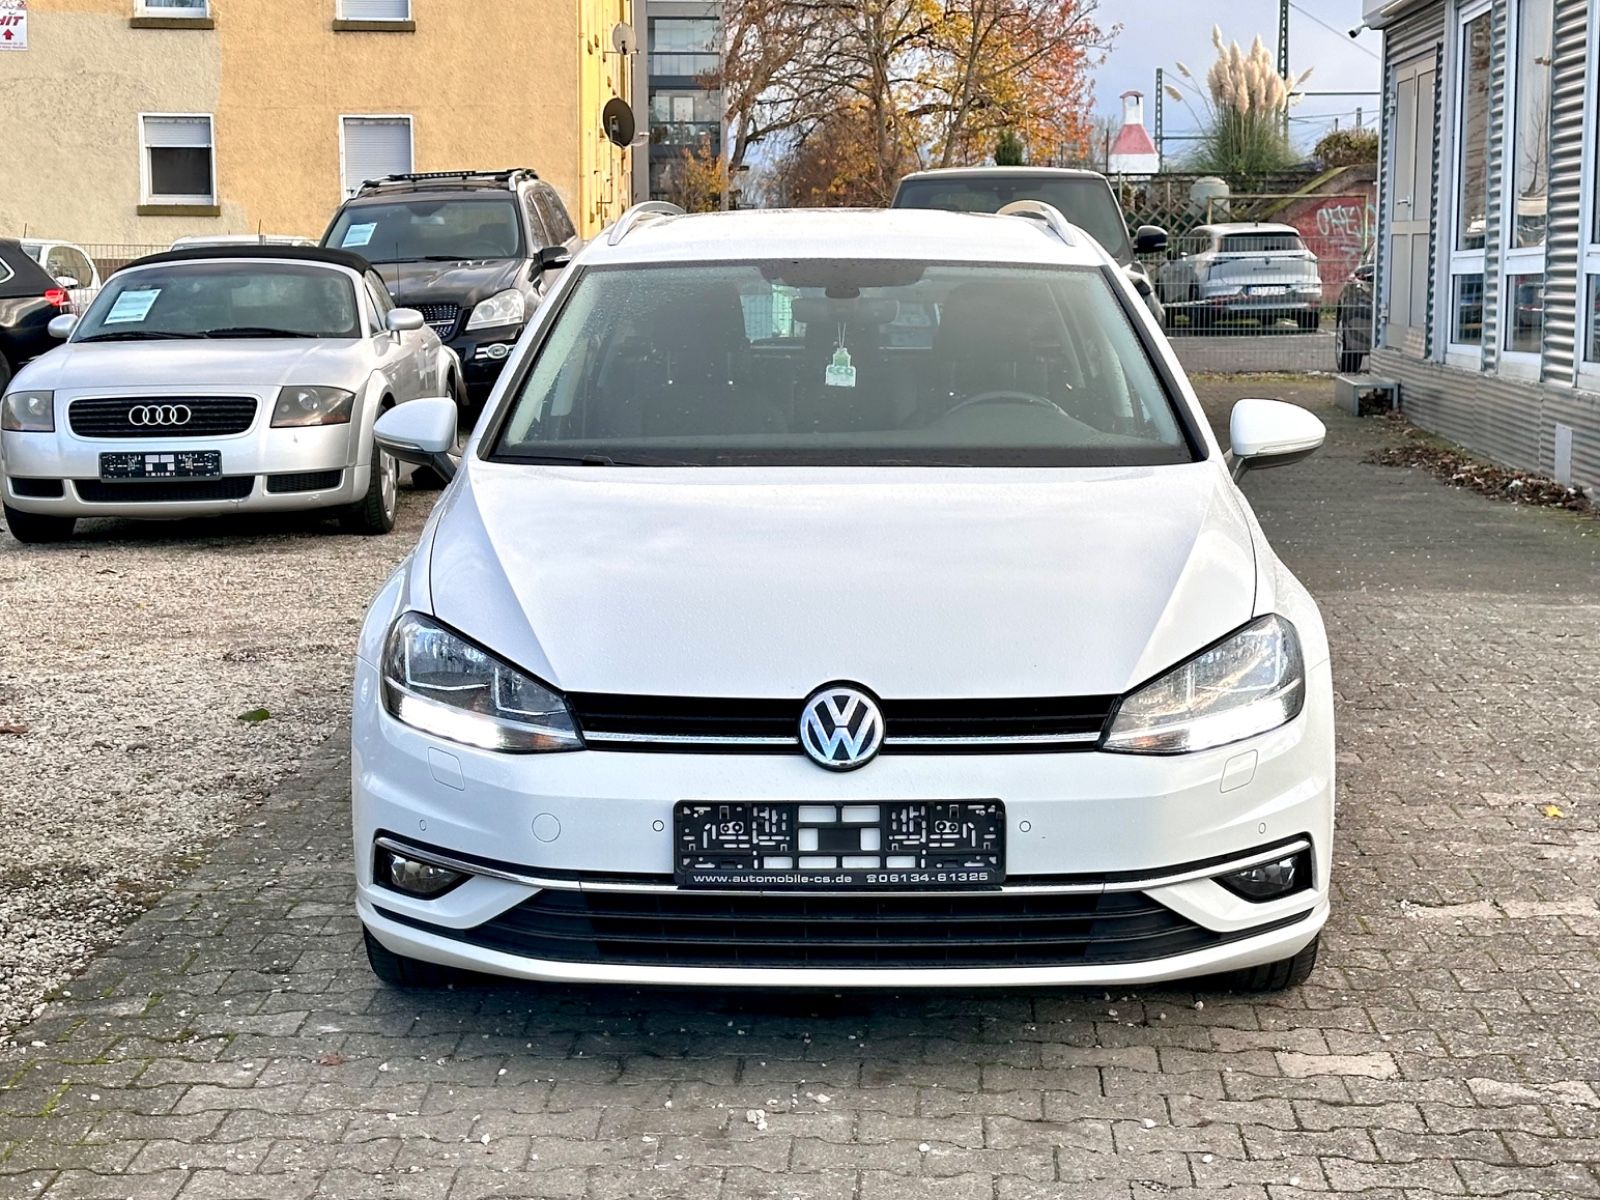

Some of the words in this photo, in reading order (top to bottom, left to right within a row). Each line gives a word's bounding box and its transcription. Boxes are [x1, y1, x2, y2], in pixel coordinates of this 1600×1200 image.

[803, 690, 881, 764] VW
[693, 874, 853, 884] www.automobile-cs.de
[878, 872, 989, 883] 06134-61325
